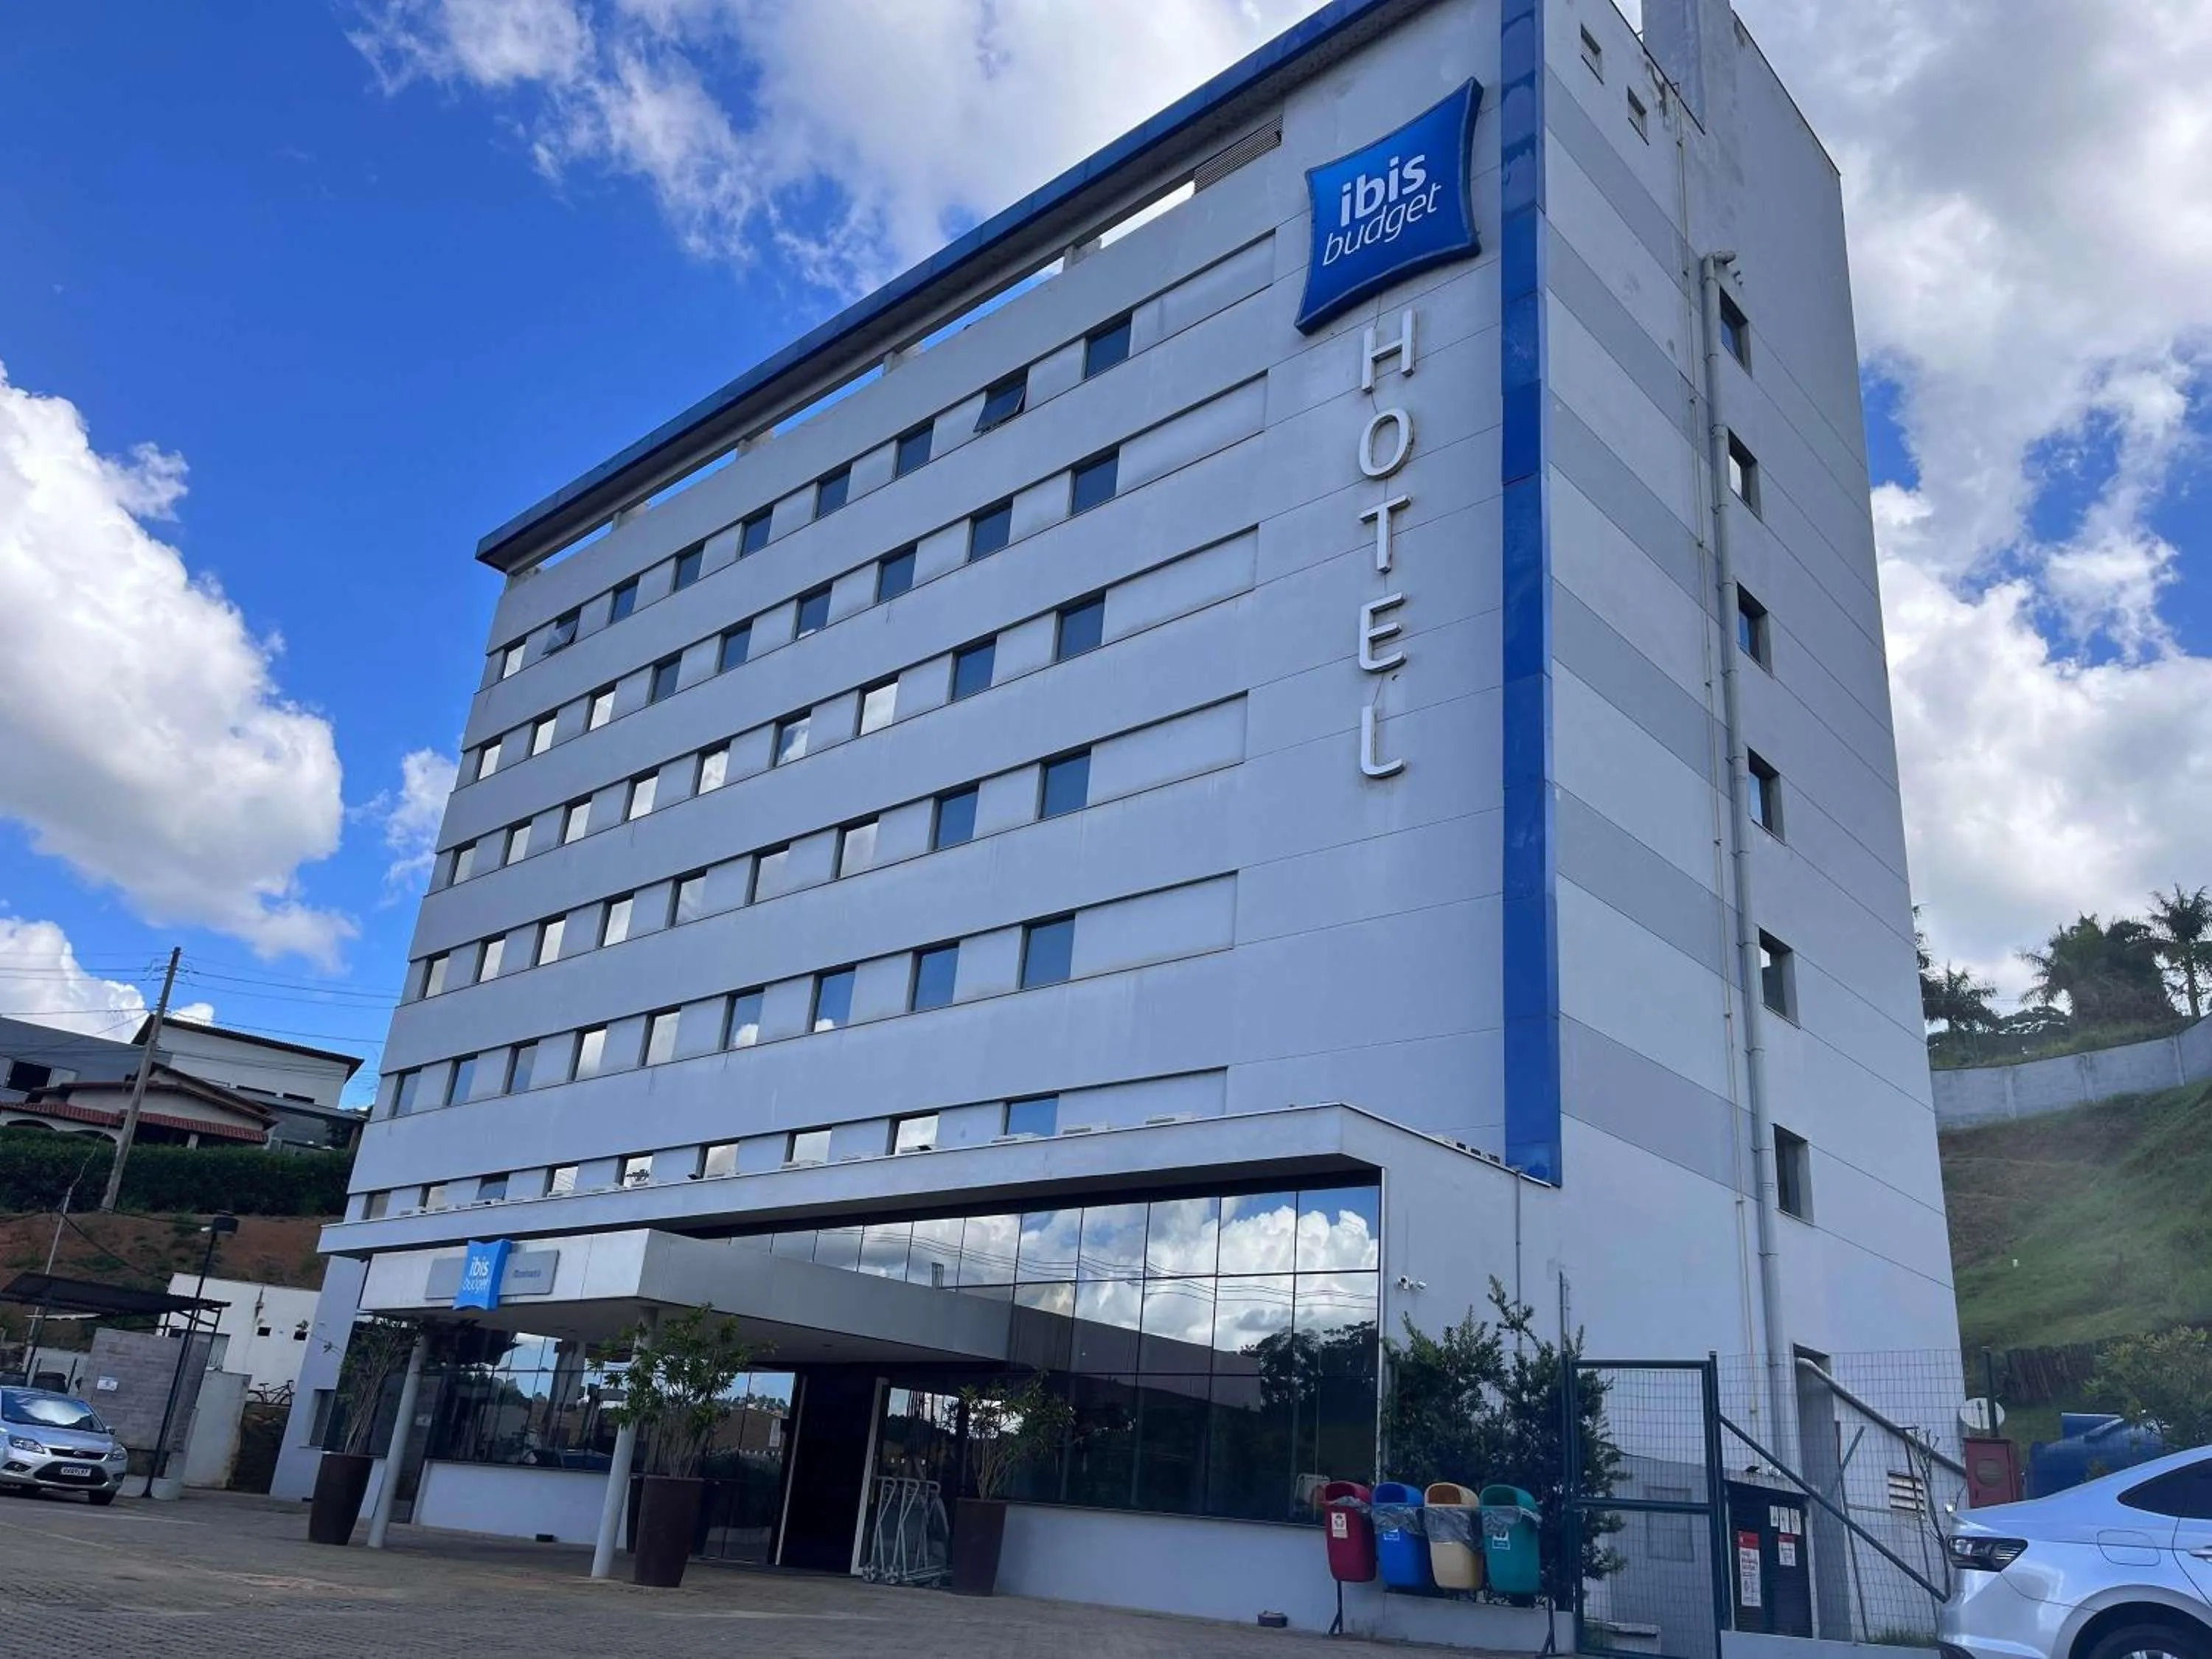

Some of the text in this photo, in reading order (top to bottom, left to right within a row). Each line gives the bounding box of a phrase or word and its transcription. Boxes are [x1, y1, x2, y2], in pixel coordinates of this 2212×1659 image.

[1323, 183, 1441, 266] budget
[1340, 155, 1427, 226] ibis
[1359, 308, 1416, 778] HOTEL
[470, 1256, 490, 1276] ibis
